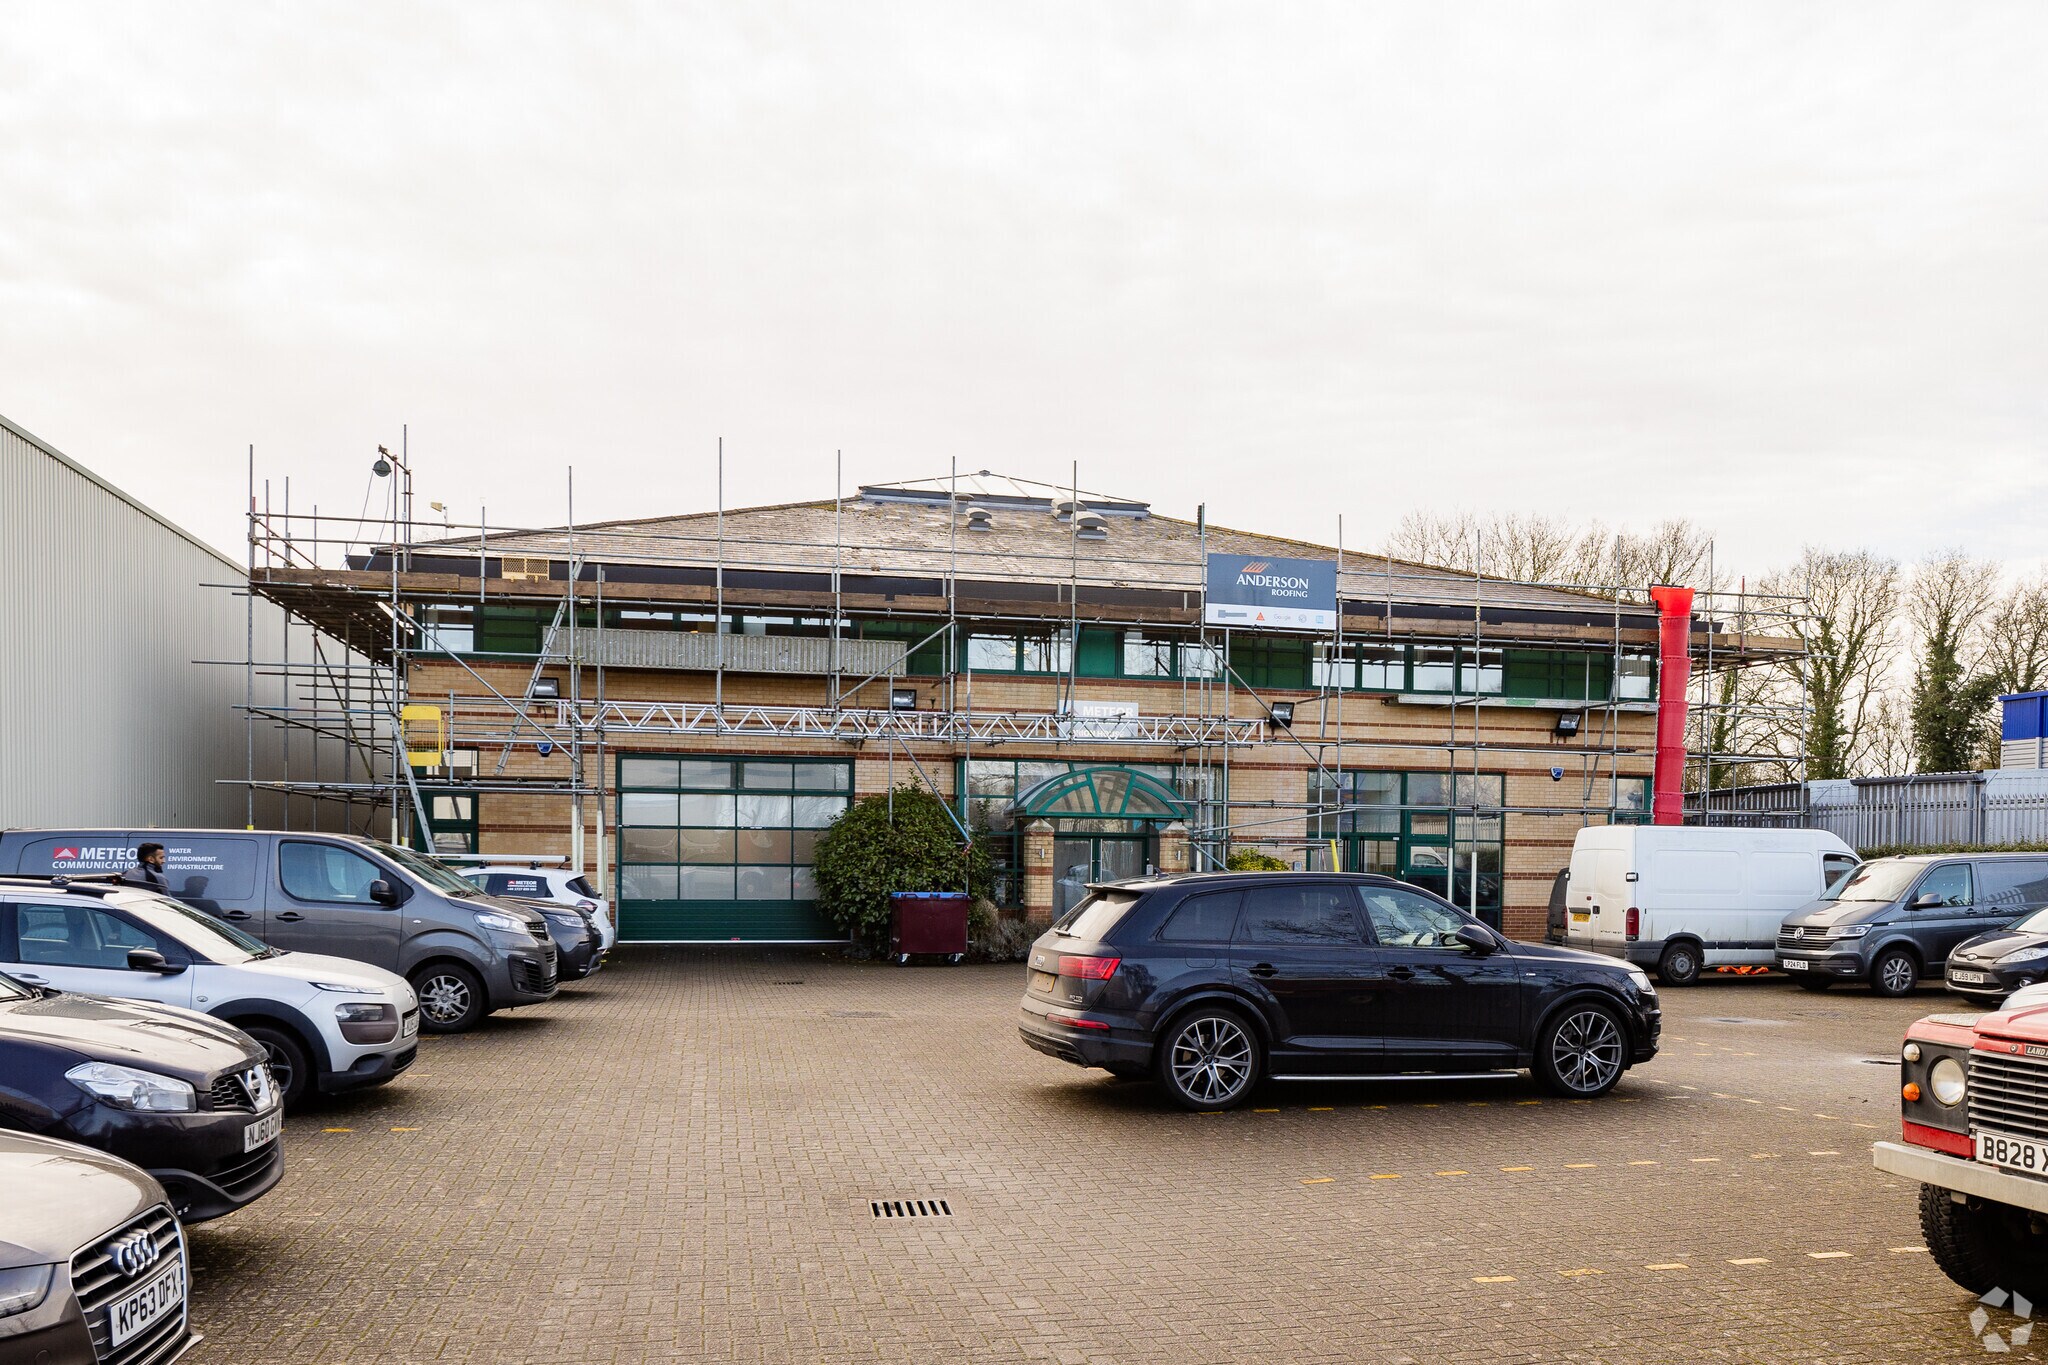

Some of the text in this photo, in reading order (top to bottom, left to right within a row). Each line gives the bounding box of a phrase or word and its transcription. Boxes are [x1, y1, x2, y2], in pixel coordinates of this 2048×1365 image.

[1236, 573, 1309, 590] ANDERSON
[1271, 588, 1308, 598] ROOFING
[1082, 705, 1134, 718] METEOR
[80, 847, 139, 860] METEO
[2026, 1046, 2046, 1056] LAND
[248, 1119, 270, 1147] NJ60
[1983, 1135, 2035, 1169] B828
[119, 1268, 178, 1336] KP63 DFX
